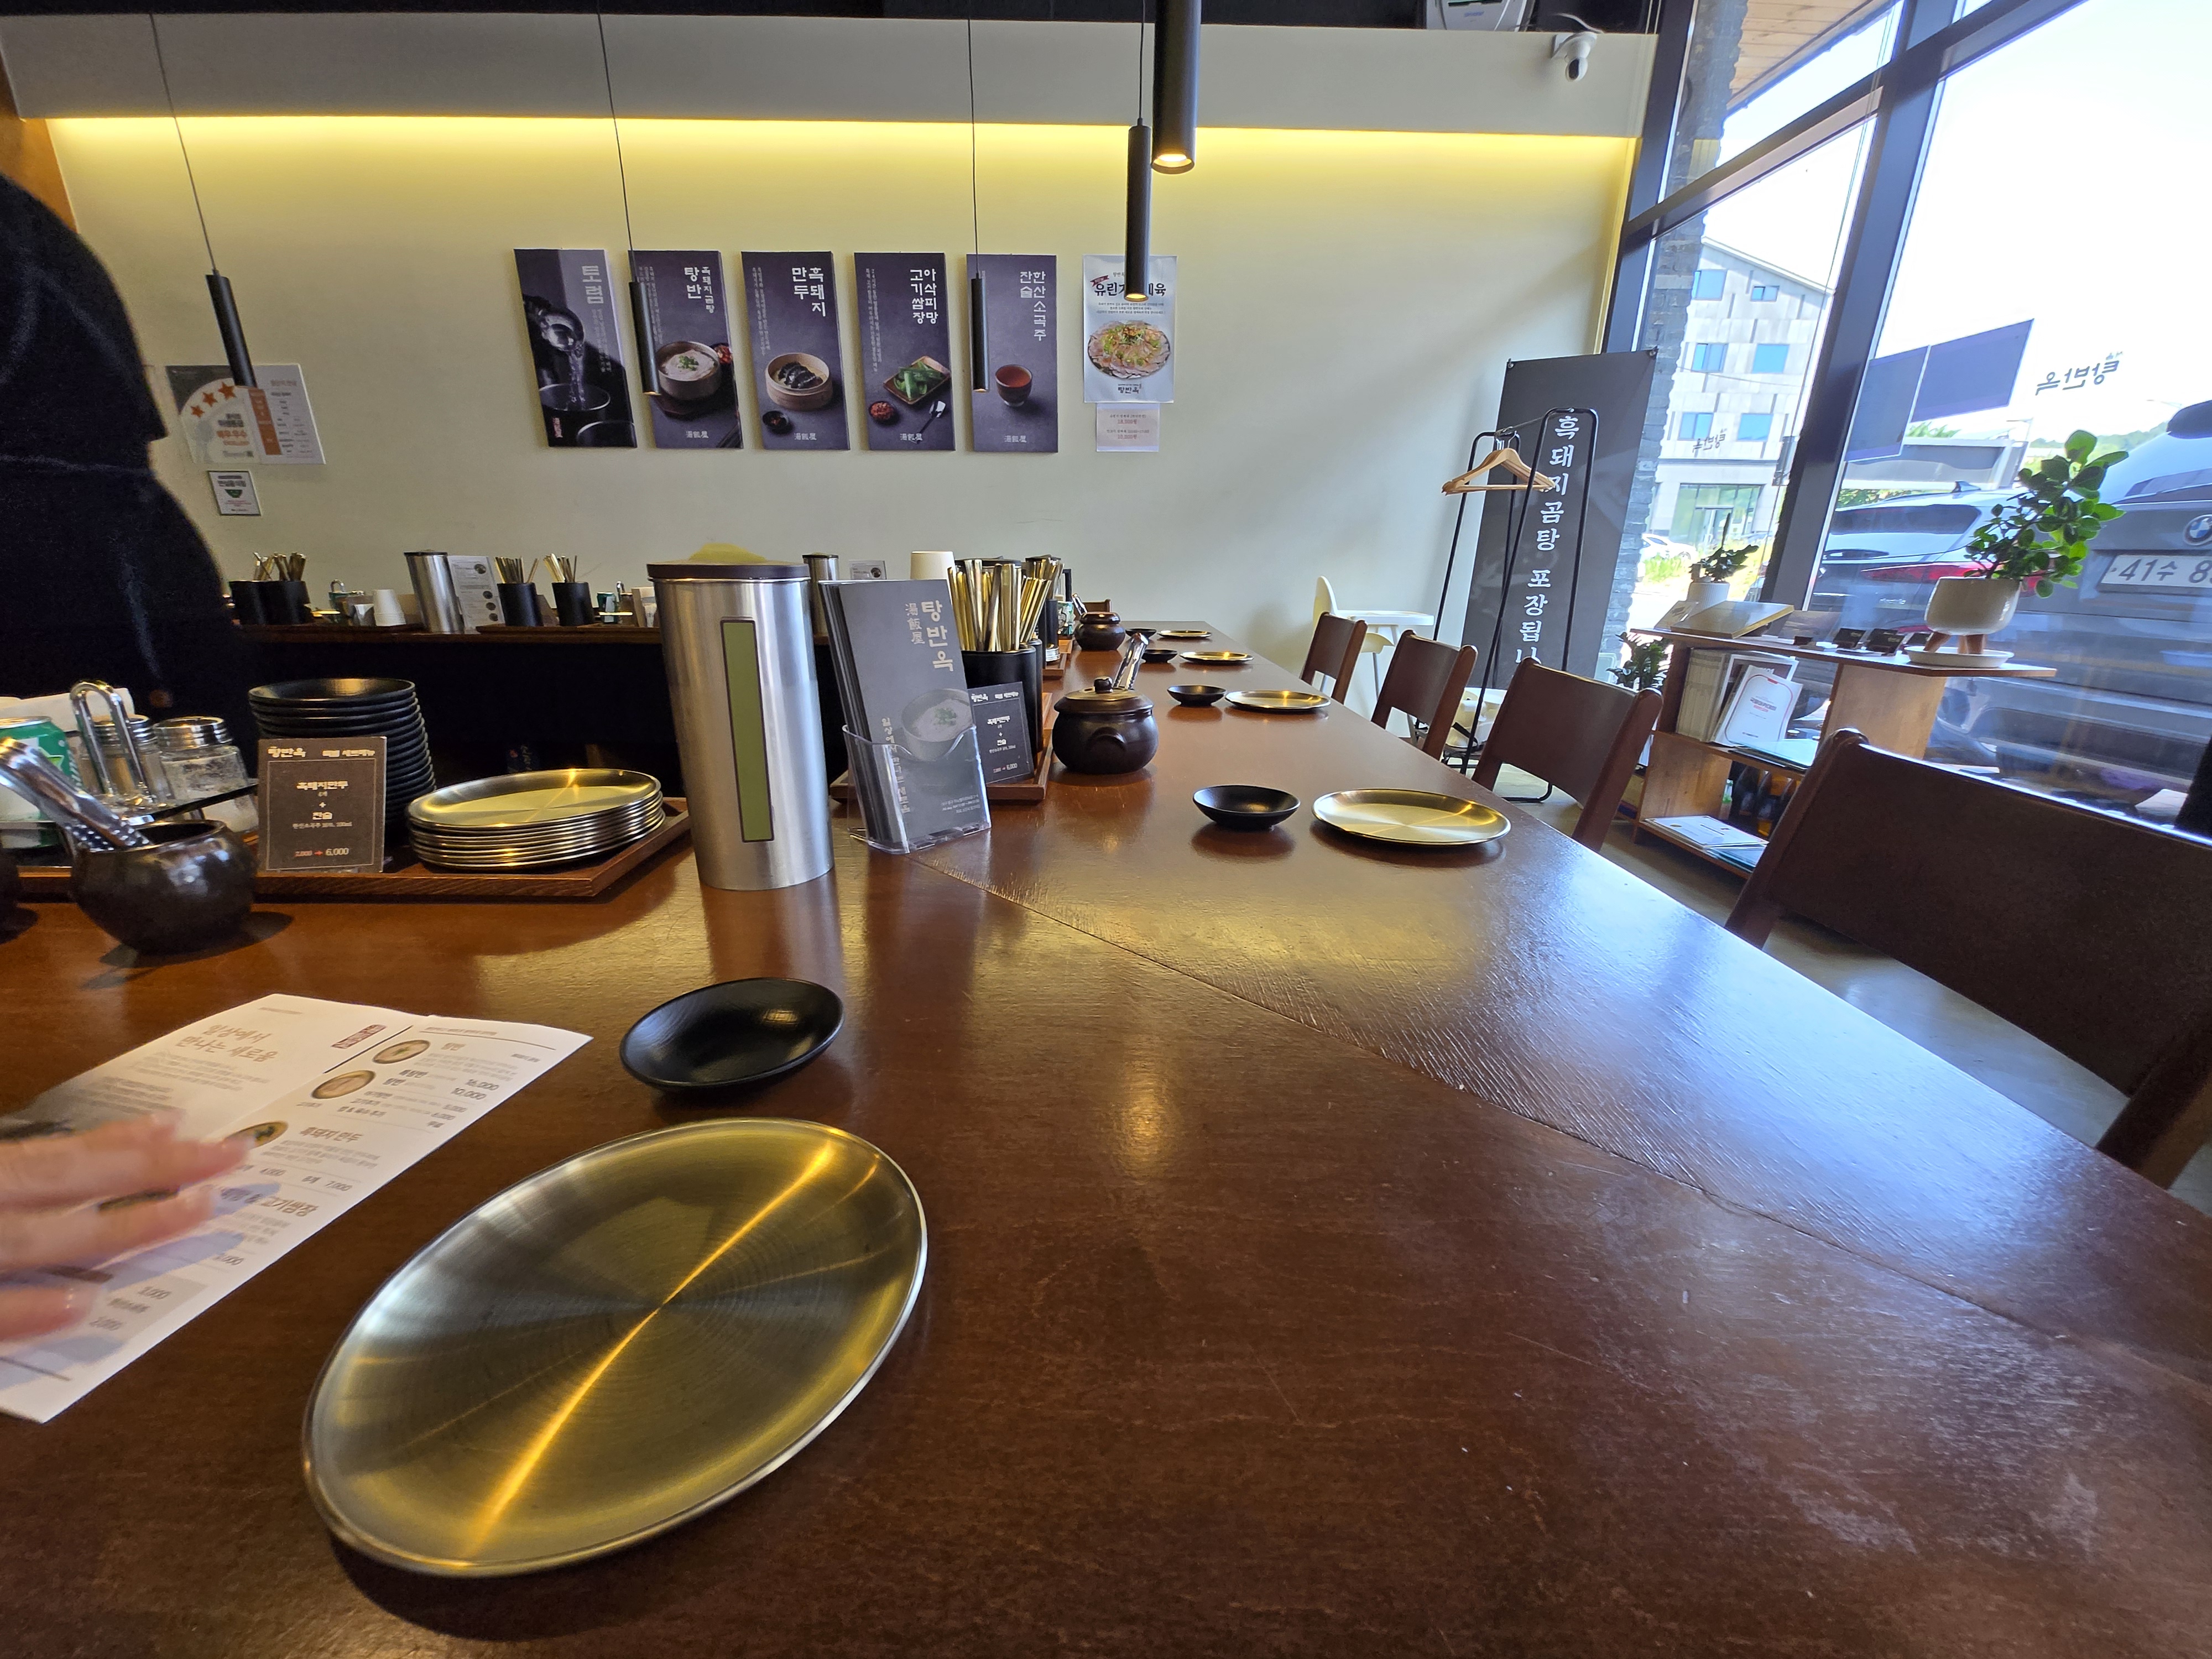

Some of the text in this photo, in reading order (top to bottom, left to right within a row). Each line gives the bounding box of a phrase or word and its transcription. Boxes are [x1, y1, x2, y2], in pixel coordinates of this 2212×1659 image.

[582, 265, 604, 304] 토렴
[684, 267, 702, 299] 탕반
[792, 267, 809, 300] 만두
[808, 267, 826, 317] 흑돼지
[910, 269, 925, 325] 고기쌈장
[924, 268, 938, 325] 아삭피망
[1020, 270, 1033, 299] 잔술
[1033, 270, 1047, 342] 한산소곡주
[1536, 415, 1580, 551] 흑돼지곰탕
[2118, 559, 2177, 581] 41수
[905, 603, 925, 644] 湯飯屋
[921, 600, 953, 671] 탕반옥
[175, 1036, 278, 1062] 만나는 새로움
[202, 1024, 273, 1045] 일상에서
